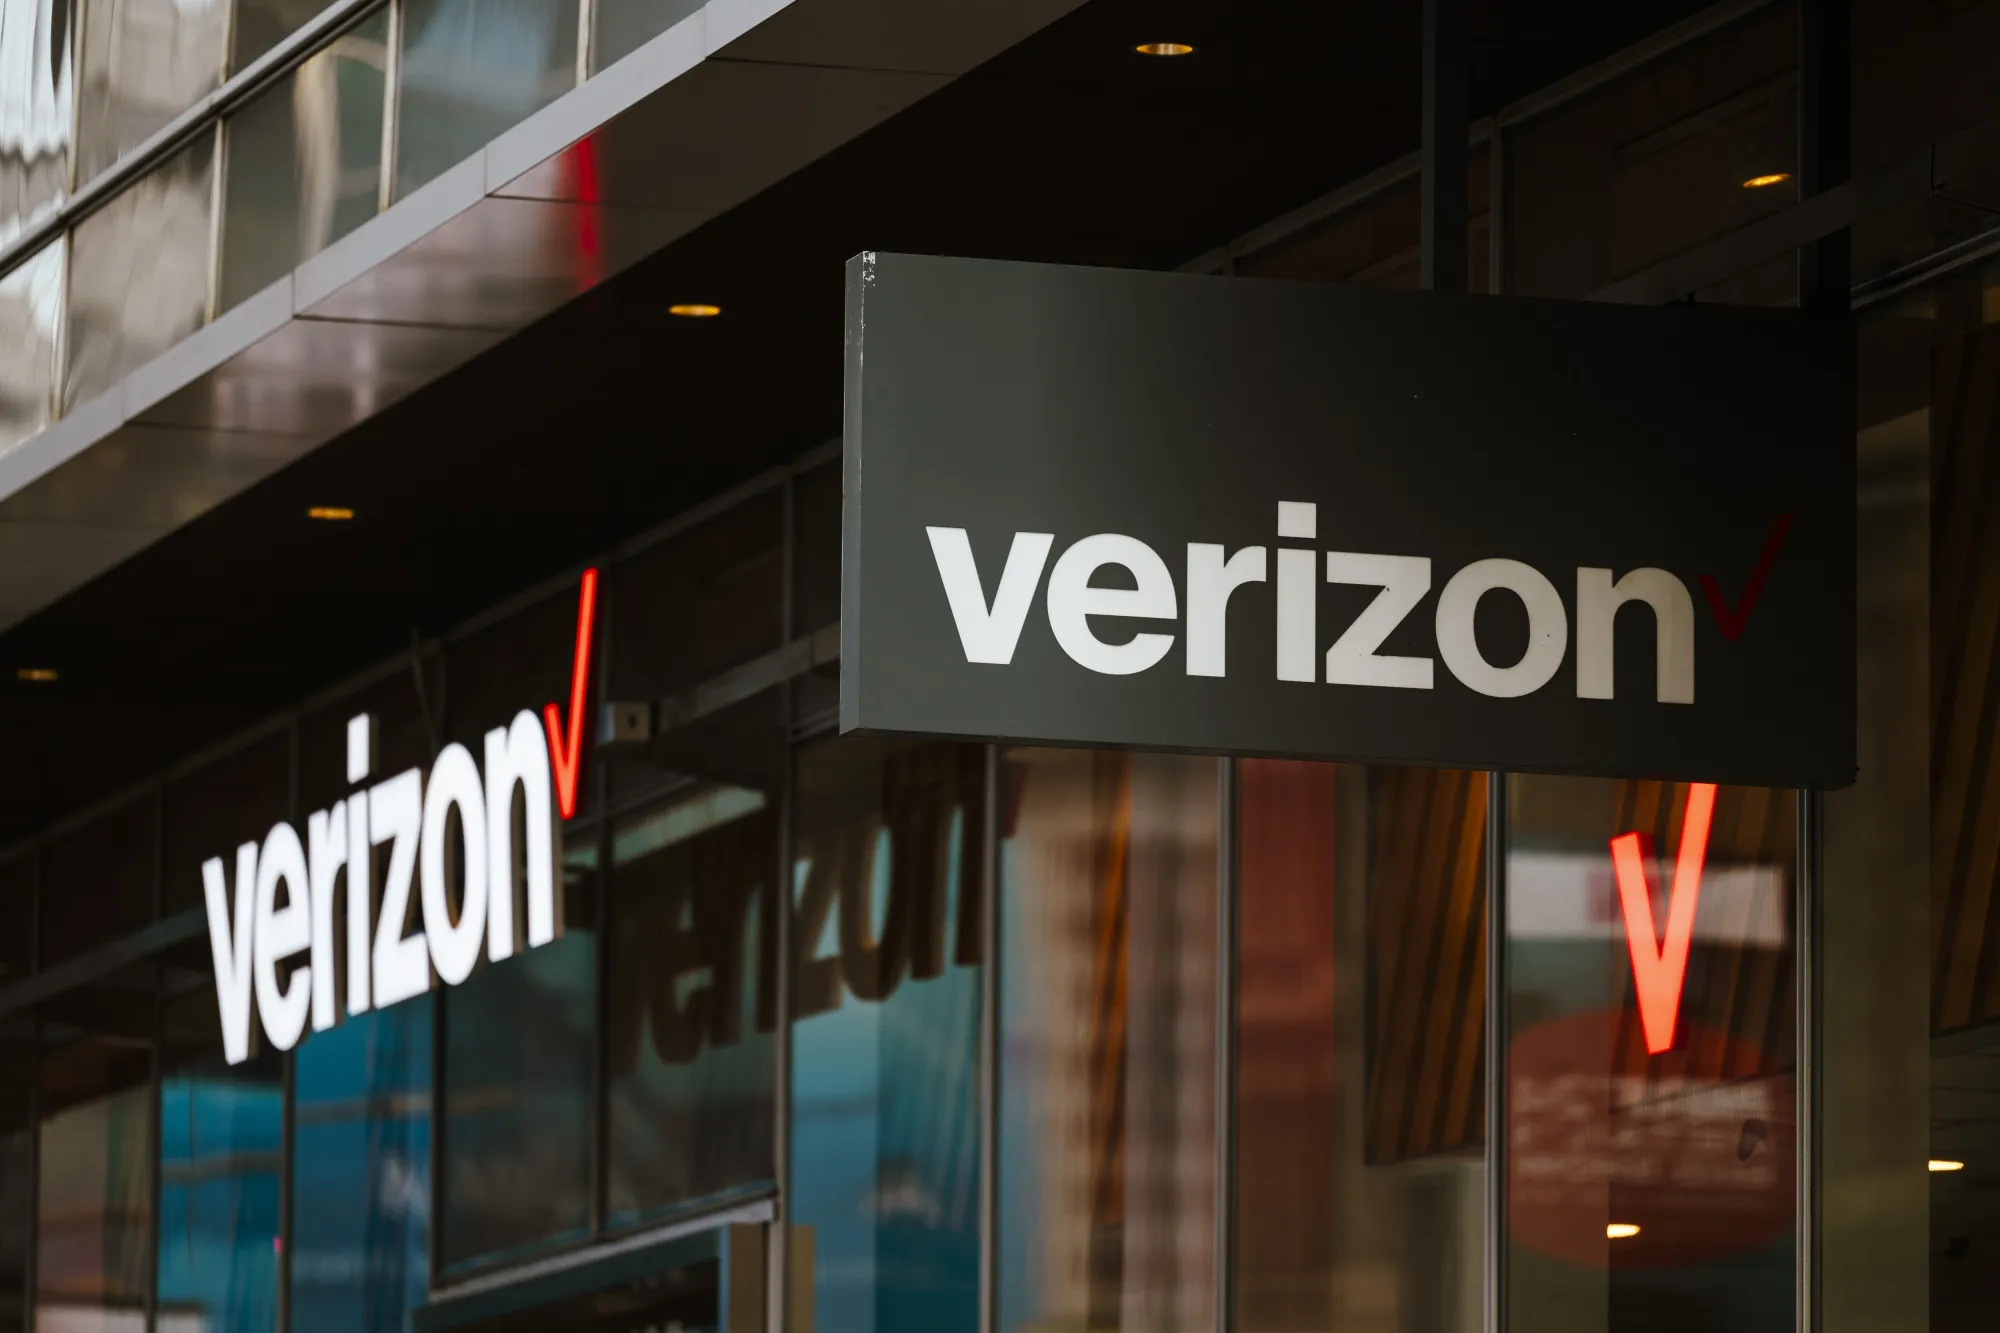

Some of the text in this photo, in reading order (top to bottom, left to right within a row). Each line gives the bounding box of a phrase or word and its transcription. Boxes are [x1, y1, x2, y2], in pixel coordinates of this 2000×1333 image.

[924, 500, 1695, 706] verizon
[203, 708, 557, 1063] verizon
[607, 742, 983, 1078] erizon
